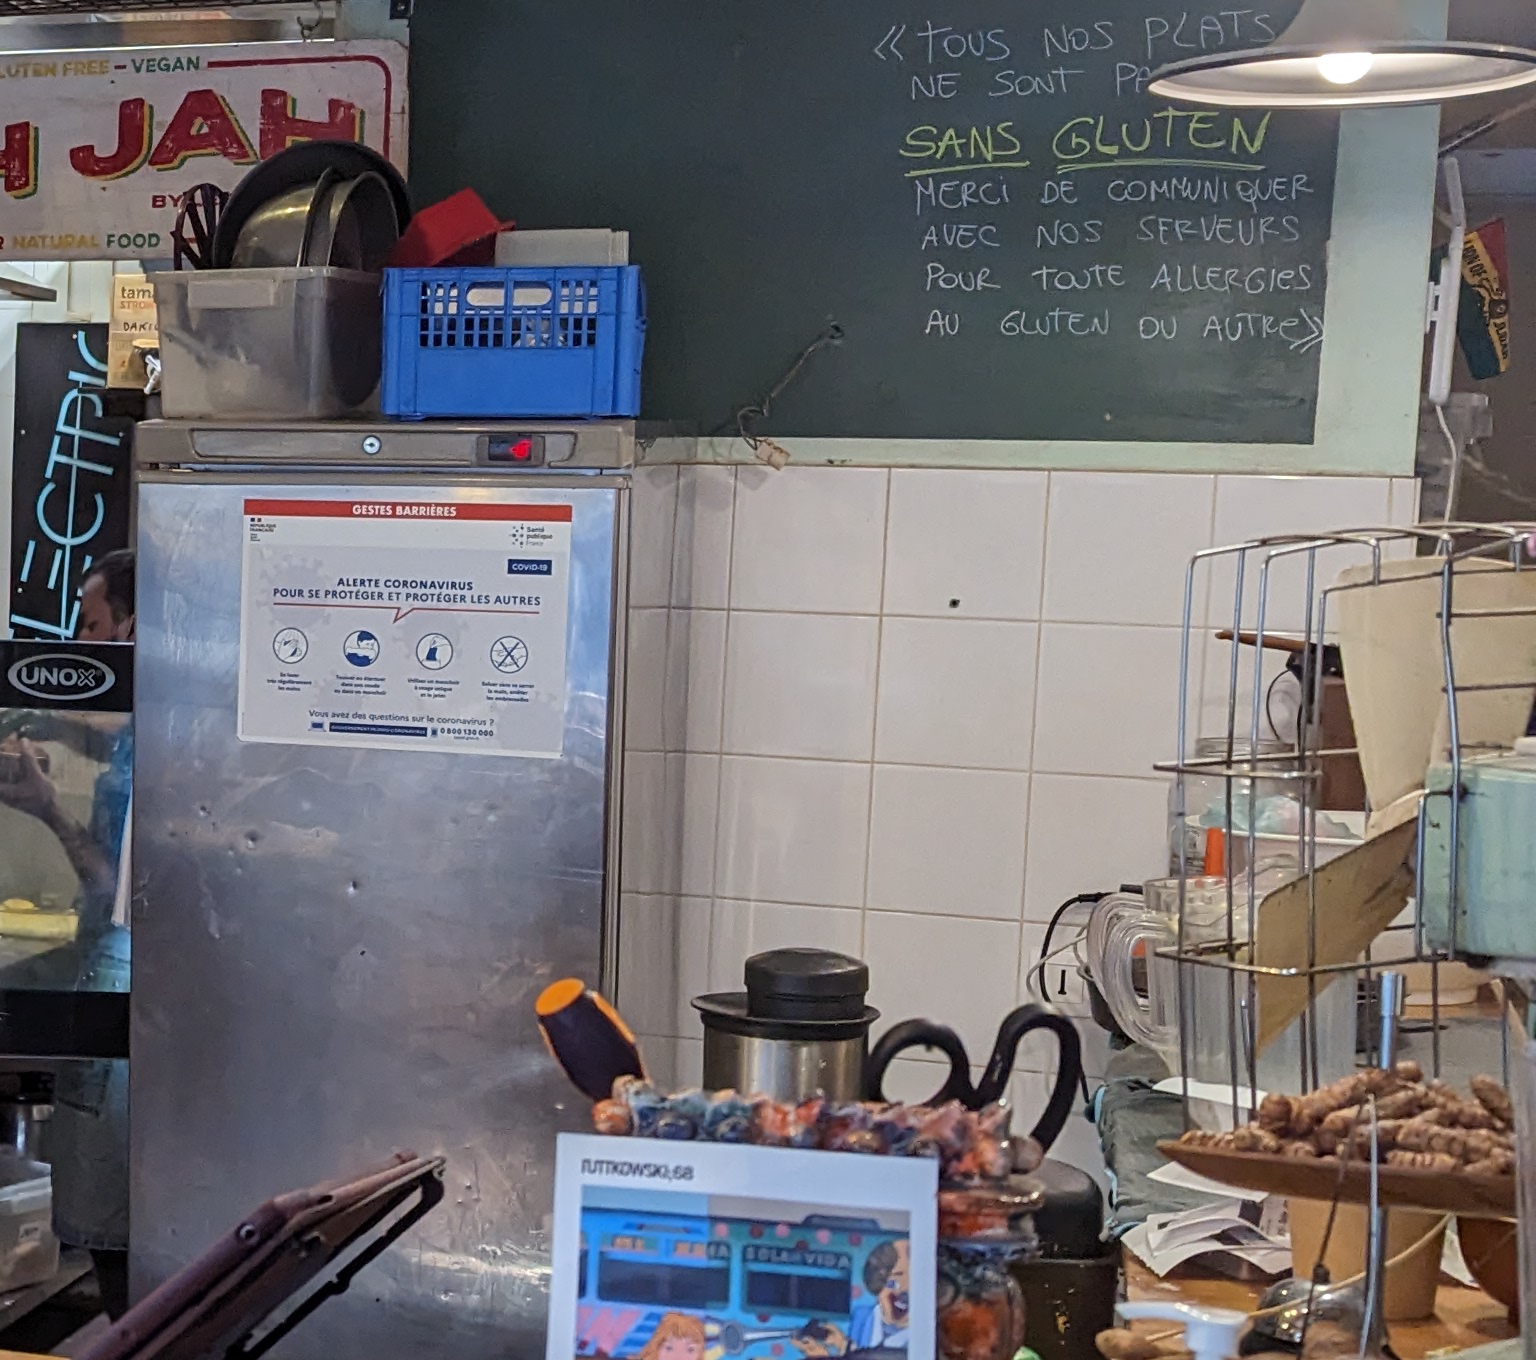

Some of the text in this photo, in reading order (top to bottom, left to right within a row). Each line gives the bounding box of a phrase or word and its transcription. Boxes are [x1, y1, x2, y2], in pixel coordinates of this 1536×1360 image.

[1044, 21, 1113, 57] NOS
[1145, 10, 1275, 55] PLATS
[63, 60, 110, 77] FREE
[131, 57, 201, 73] VEGAN
[911, 64, 1156, 100] NE SONT PA
[69, 88, 366, 182] JAH
[900, 106, 1272, 160] SANS GLUTEN
[1041, 180, 1078, 204] DE
[1107, 174, 1315, 214] COMMUNIQUER
[12, 233, 100, 251] NATURAL
[106, 232, 161, 249] FOOD
[922, 215, 1300, 250] AVEC NOS SERVEURS
[926, 264, 1001, 292] POUR
[1032, 264, 1126, 292] TOUTE
[925, 309, 961, 335] AU
[1001, 308, 1110, 336] GLUTEN
[1140, 314, 1177, 339] OU
[352, 504, 457, 517] GESTES BARRIÈRES
[273, 588, 541, 606] POUR SE PROTÉGER ET PROTÉGER LES AUTRES
[337, 578, 473, 591] ALERTE CORONAVIRUS
[21, 666, 96, 687] UNOX
[309, 710, 329, 718] Vous
[331, 711, 350, 719] avez
[351, 711, 366, 720] des
[368, 713, 409, 722] questions
[426, 715, 435, 723] le
[437, 717, 487, 726] coronavirus
